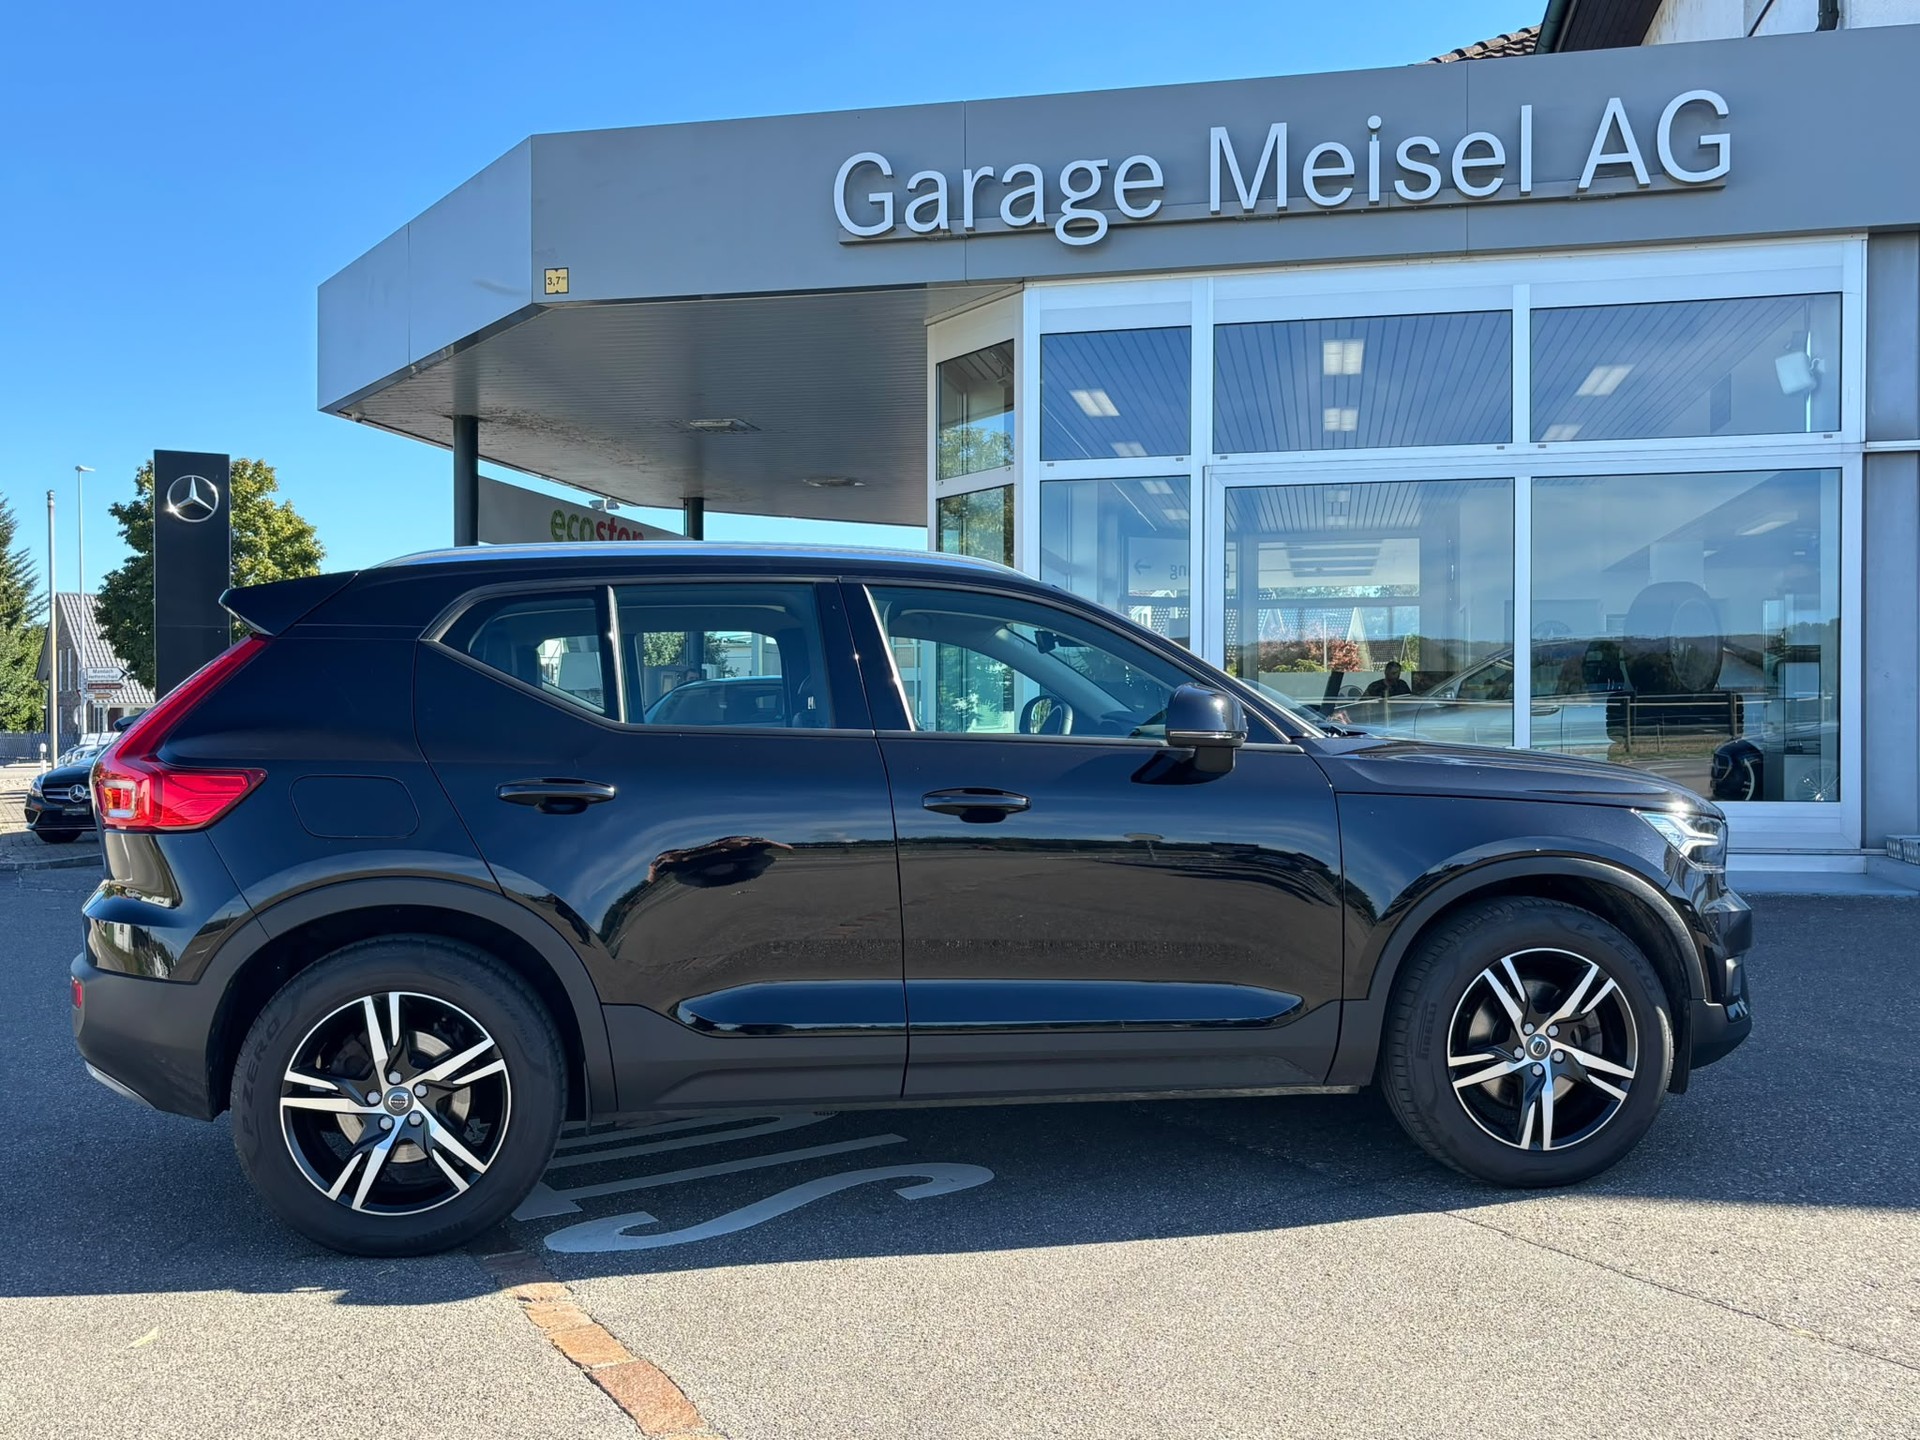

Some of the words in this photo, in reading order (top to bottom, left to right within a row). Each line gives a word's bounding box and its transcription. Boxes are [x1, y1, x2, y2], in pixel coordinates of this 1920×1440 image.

[832, 151, 1164, 247] Garage
[1209, 105, 1533, 215] Meisel
[1577, 89, 1732, 192] AG
[241, 1017, 281, 1109] ZERO
